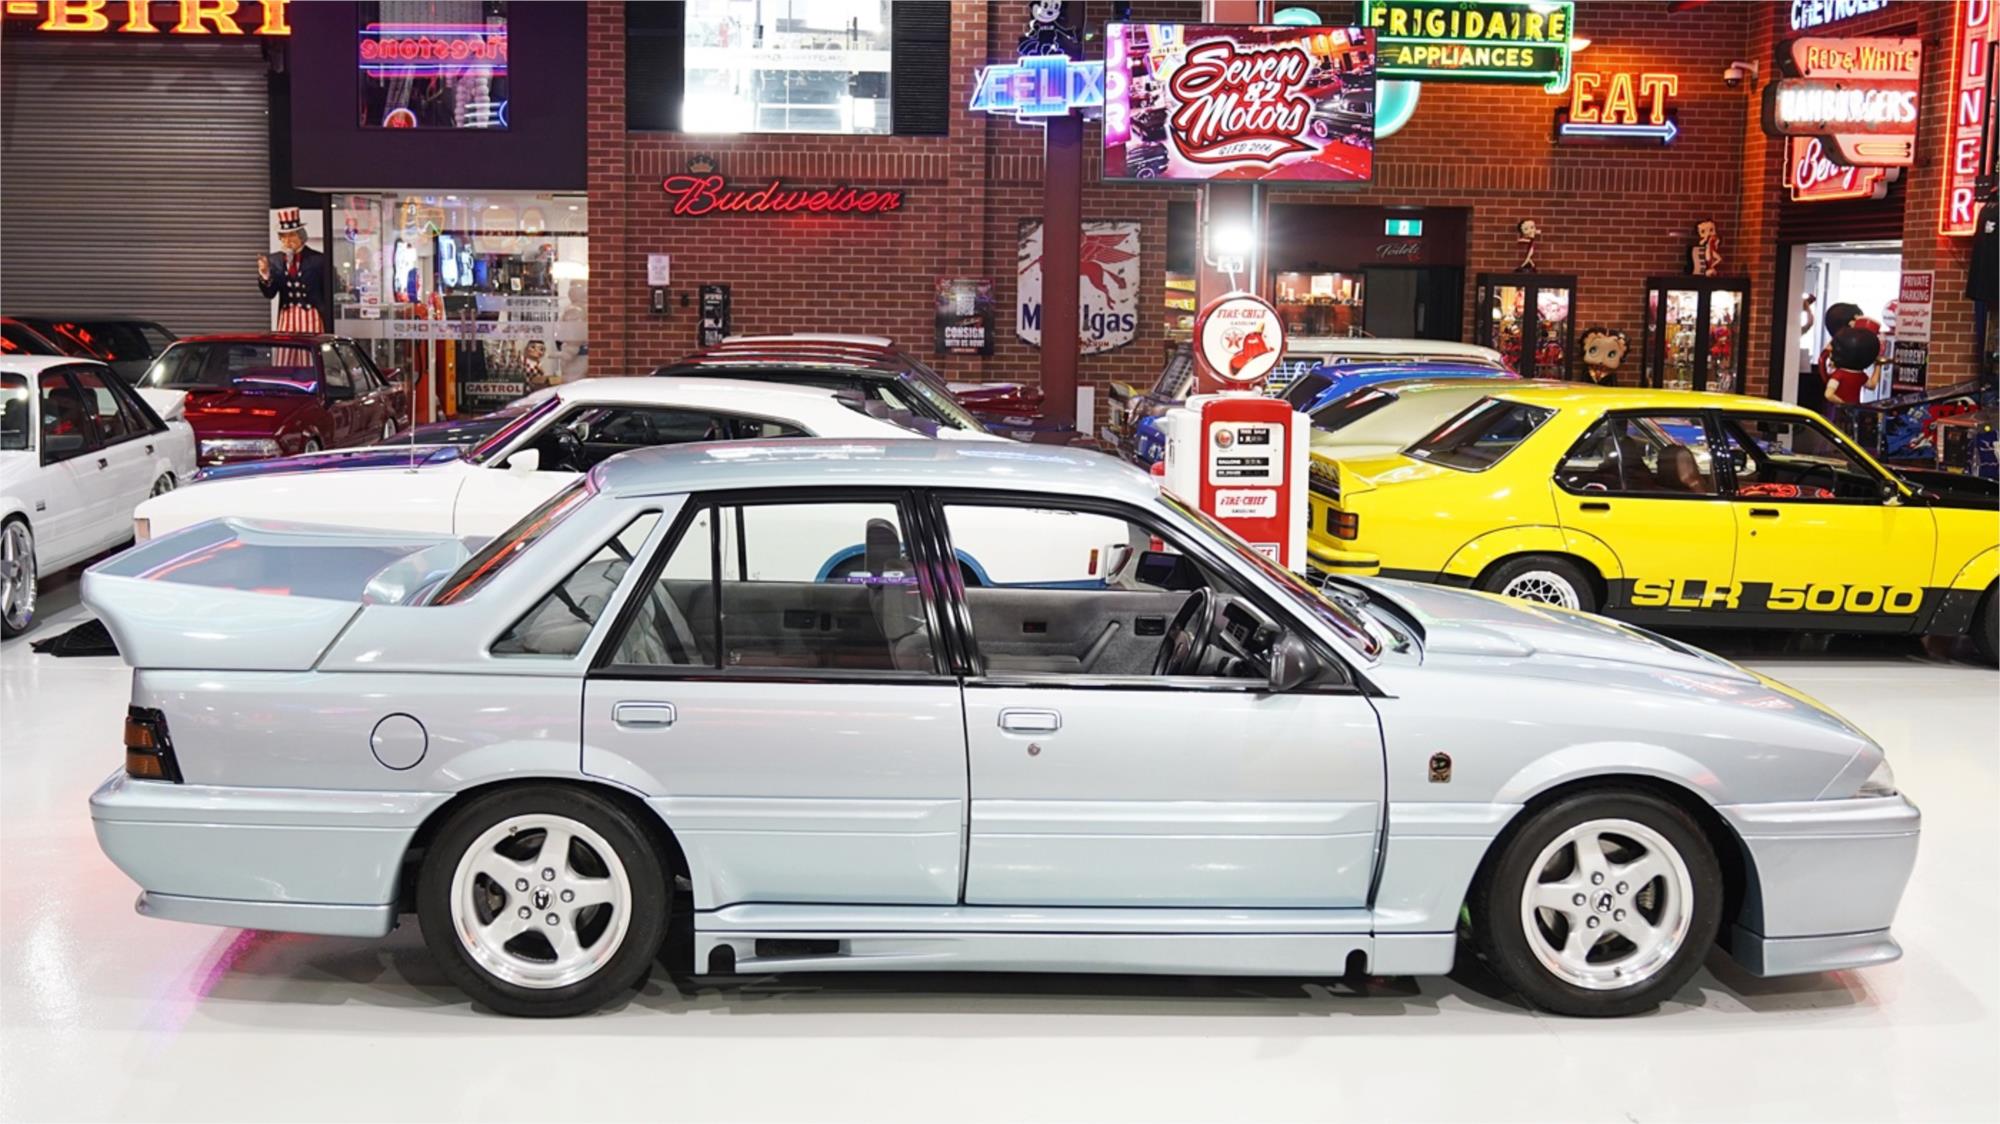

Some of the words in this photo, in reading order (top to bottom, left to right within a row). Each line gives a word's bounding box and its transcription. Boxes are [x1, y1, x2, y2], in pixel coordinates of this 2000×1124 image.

[1371, 7, 1567, 41] FRIGIDAIRE
[1791, 0, 1888, 30] CHEVRO
[1397, 46, 1534, 67] APPLIANCES
[1808, 47, 1838, 68] RED
[1843, 54, 1855, 72] &
[1859, 47, 1914, 71] WHITE
[989, 67, 1104, 104] FELIX
[1176, 47, 1301, 98] Seven
[1244, 81, 1282, 103] 82
[1570, 73, 1678, 124] EAT
[1779, 89, 1917, 122] HAMBURGERS
[1179, 94, 1304, 144] Motors
[1951, 0, 1989, 223] DINER
[663, 176, 902, 215] Budweiser
[1902, 290, 1930, 301] PARKING
[1903, 275, 1930, 287] PRIVATE
[944, 326, 985, 338] CONSIGN
[1022, 303, 1135, 339] Mlgas
[1895, 349, 1926, 364] CURRENT
[466, 384, 521, 393] CASTROL
[1221, 496, 1268, 505] FIRE-CHIEF
[1631, 578, 1743, 609] SLR
[1766, 582, 1924, 614] 5000
